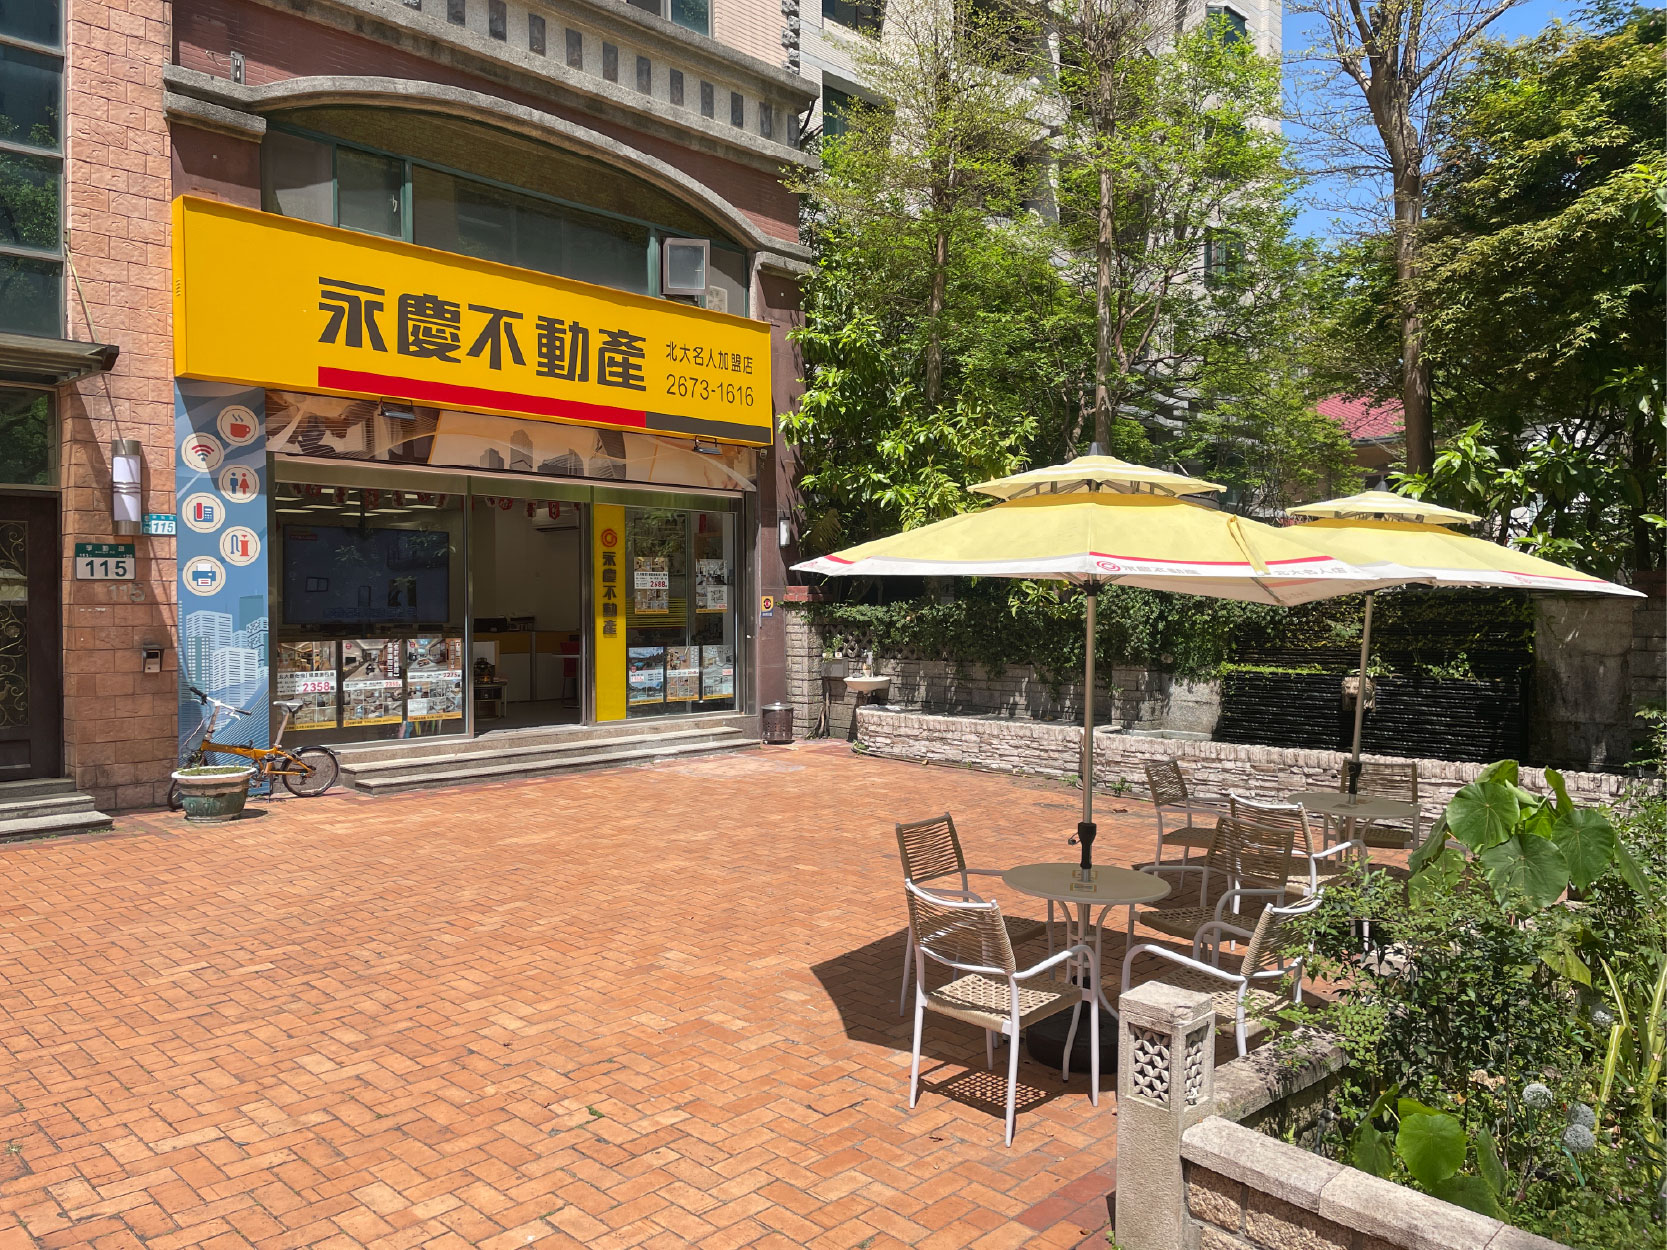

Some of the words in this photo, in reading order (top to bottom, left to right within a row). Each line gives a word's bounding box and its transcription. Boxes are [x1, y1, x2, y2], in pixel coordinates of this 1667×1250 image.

[318, 276, 647, 392] 永慶不動產
[665, 341, 754, 377] 北大名人加盟店
[666, 373, 755, 408] 2673-1616
[153, 522, 174, 533] 115
[86, 560, 127, 577] 115
[108, 582, 146, 602] 115
[602, 552, 618, 638] 永慶不動產
